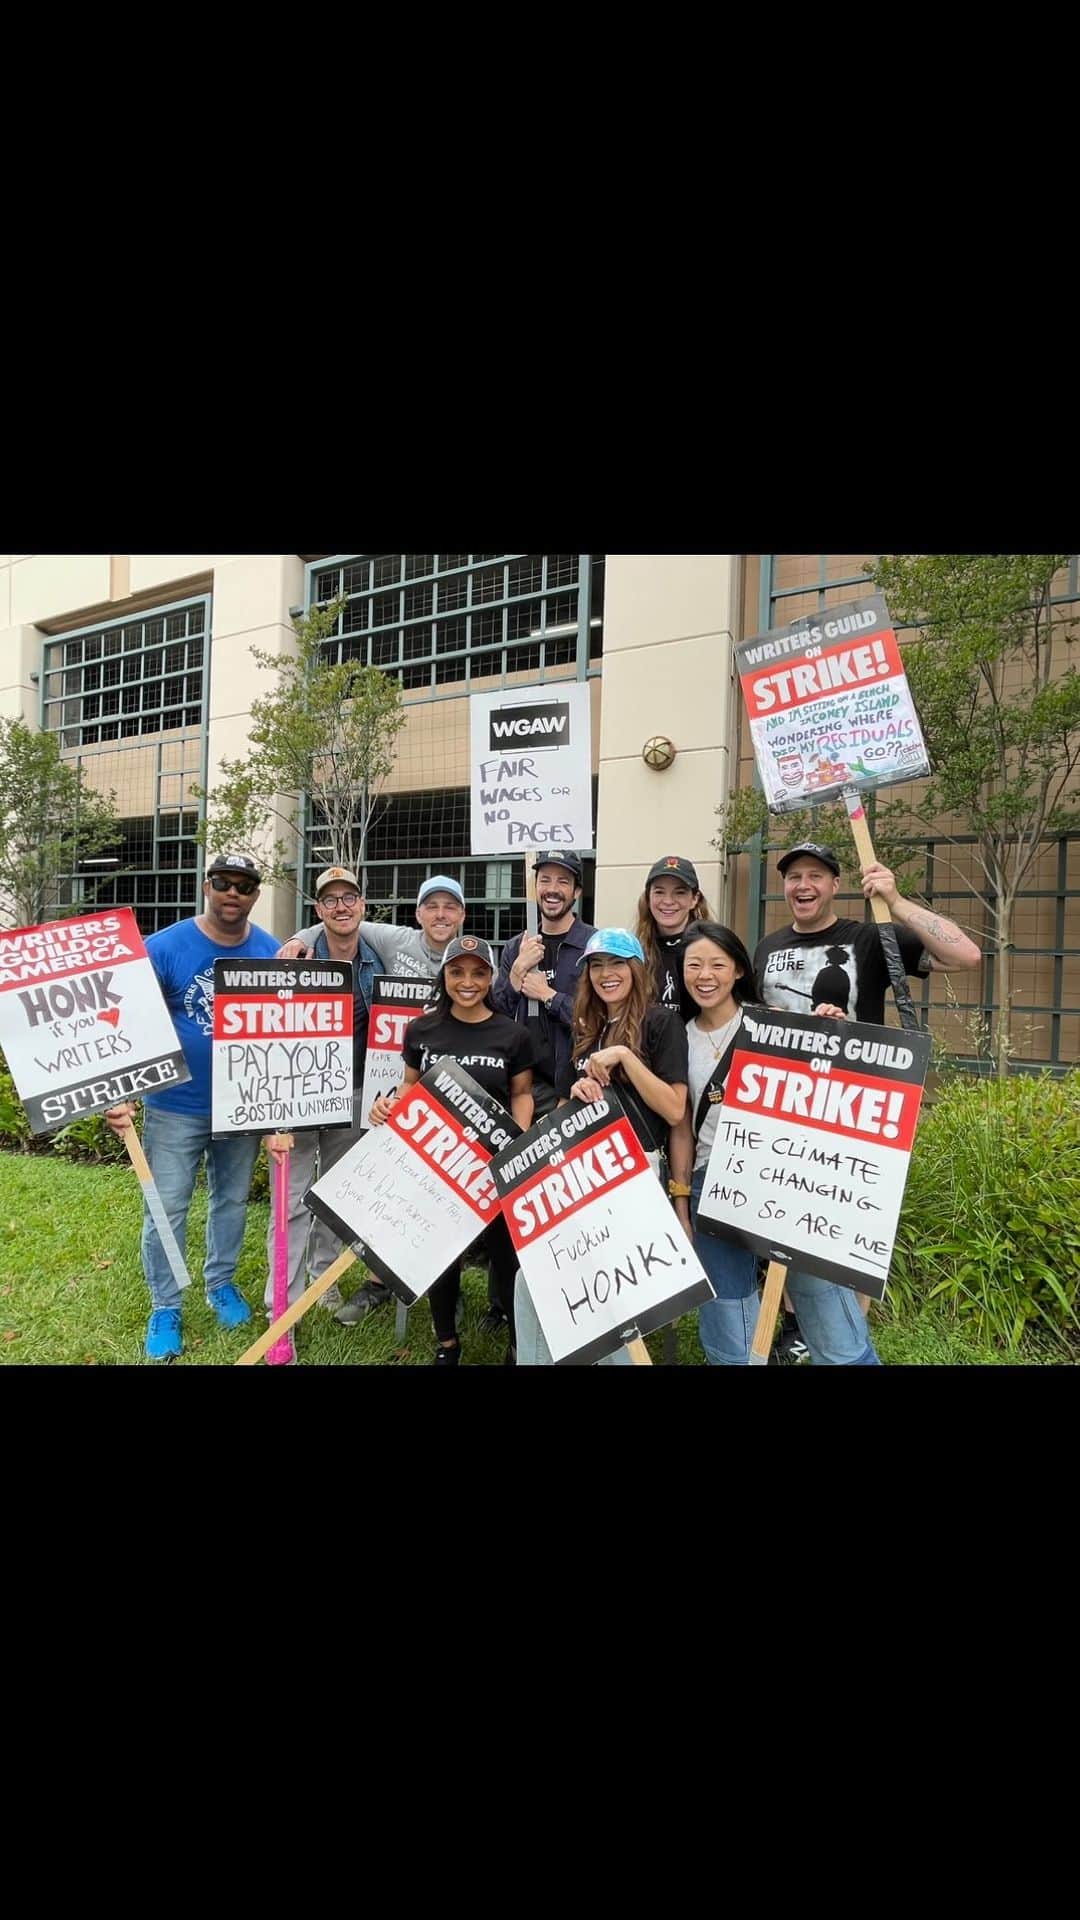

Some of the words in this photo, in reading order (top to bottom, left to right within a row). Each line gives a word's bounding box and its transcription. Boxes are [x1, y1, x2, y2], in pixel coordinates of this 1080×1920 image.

[745, 625, 823, 664] WRITERS
[824, 610, 877, 639] GUILD
[805, 646, 822, 659] ON
[753, 640, 890, 711] STRIKE!
[492, 715, 567, 737] WGAW
[766, 715, 785, 731] AND
[803, 700, 836, 714] SITTING
[857, 684, 890, 699] BENCH
[811, 705, 849, 725] CONEY
[854, 694, 900, 713] ISLAND
[768, 720, 842, 748] WONDERING
[848, 709, 893, 727] WHERE
[772, 746, 796, 758] DID
[800, 740, 815, 754] MY
[816, 719, 914, 754] RESIDUALS
[864, 741, 902, 759] GO??
[479, 758, 539, 783] FAIR
[480, 787, 542, 806] WAGES
[551, 786, 570, 796] OR
[484, 809, 510, 825] NO
[507, 821, 575, 845] PAGES
[0, 917, 121, 954] WRITERS
[0, 938, 90, 968] GUILD
[93, 934, 120, 948] OF
[0, 944, 134, 984] AMERICA
[767, 960, 805, 974] CURE
[769, 950, 795, 961] THE
[223, 970, 297, 987] WRITERS
[300, 970, 344, 987] GUILD
[277, 989, 293, 1000] ON
[17, 970, 123, 1027] HONK
[51, 1020, 64, 1038] if
[68, 1016, 95, 1038] you
[222, 1002, 344, 1034] STRIKE!
[34, 1030, 132, 1073] WRITERS
[219, 1042, 273, 1081] "PAY
[279, 1041, 342, 1075] YOUR
[751, 1022, 841, 1056] WRITERS
[844, 1039, 914, 1070] GUILD
[810, 1057, 832, 1074] ON
[41, 1058, 178, 1124] STRIKE
[238, 1066, 352, 1104] WRITERS"
[434, 1071, 495, 1135] WRITERS
[736, 1063, 904, 1140] STRIKE!
[227, 1103, 294, 1126] -BOSTON
[462, 1126, 480, 1142] ON
[499, 1127, 562, 1184] WRITERS
[561, 1099, 610, 1138] GUILD
[721, 1121, 762, 1150] THE
[549, 1149, 565, 1167] ON
[512, 1130, 636, 1237] STRIKE!
[759, 1167, 882, 1211] CHANGING
[708, 1183, 747, 1208] AND
[796, 1213, 843, 1239] ARE
[854, 1232, 890, 1256] WE
[548, 1208, 612, 1270] Fuckin'
[561, 1233, 687, 1325] HONK!
